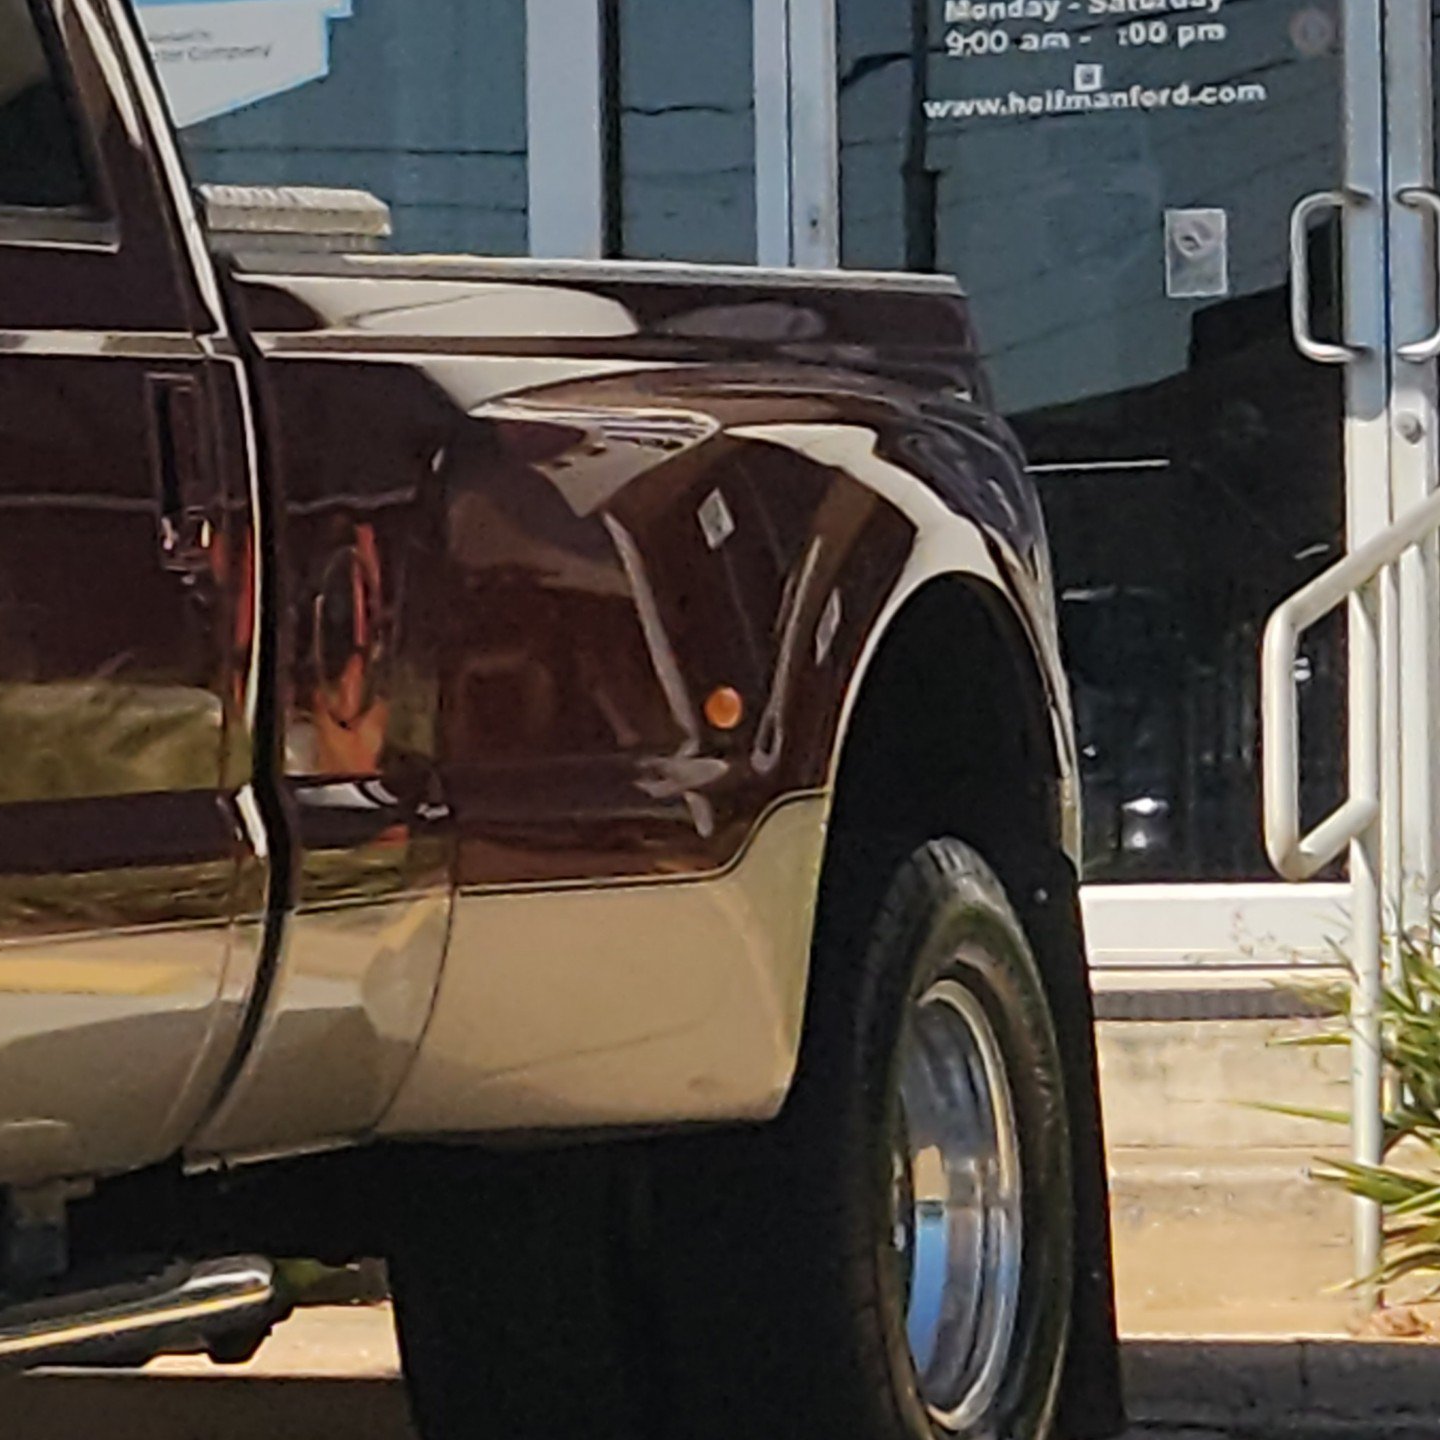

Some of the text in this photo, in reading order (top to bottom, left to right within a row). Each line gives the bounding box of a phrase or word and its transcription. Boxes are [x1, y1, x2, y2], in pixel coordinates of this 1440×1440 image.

[944, 29, 1009, 57] 9:00
[1018, 33, 1071, 52] am
[1177, 22, 1227, 49] pm
[922, 80, 1267, 120] www.helfmanford.com
